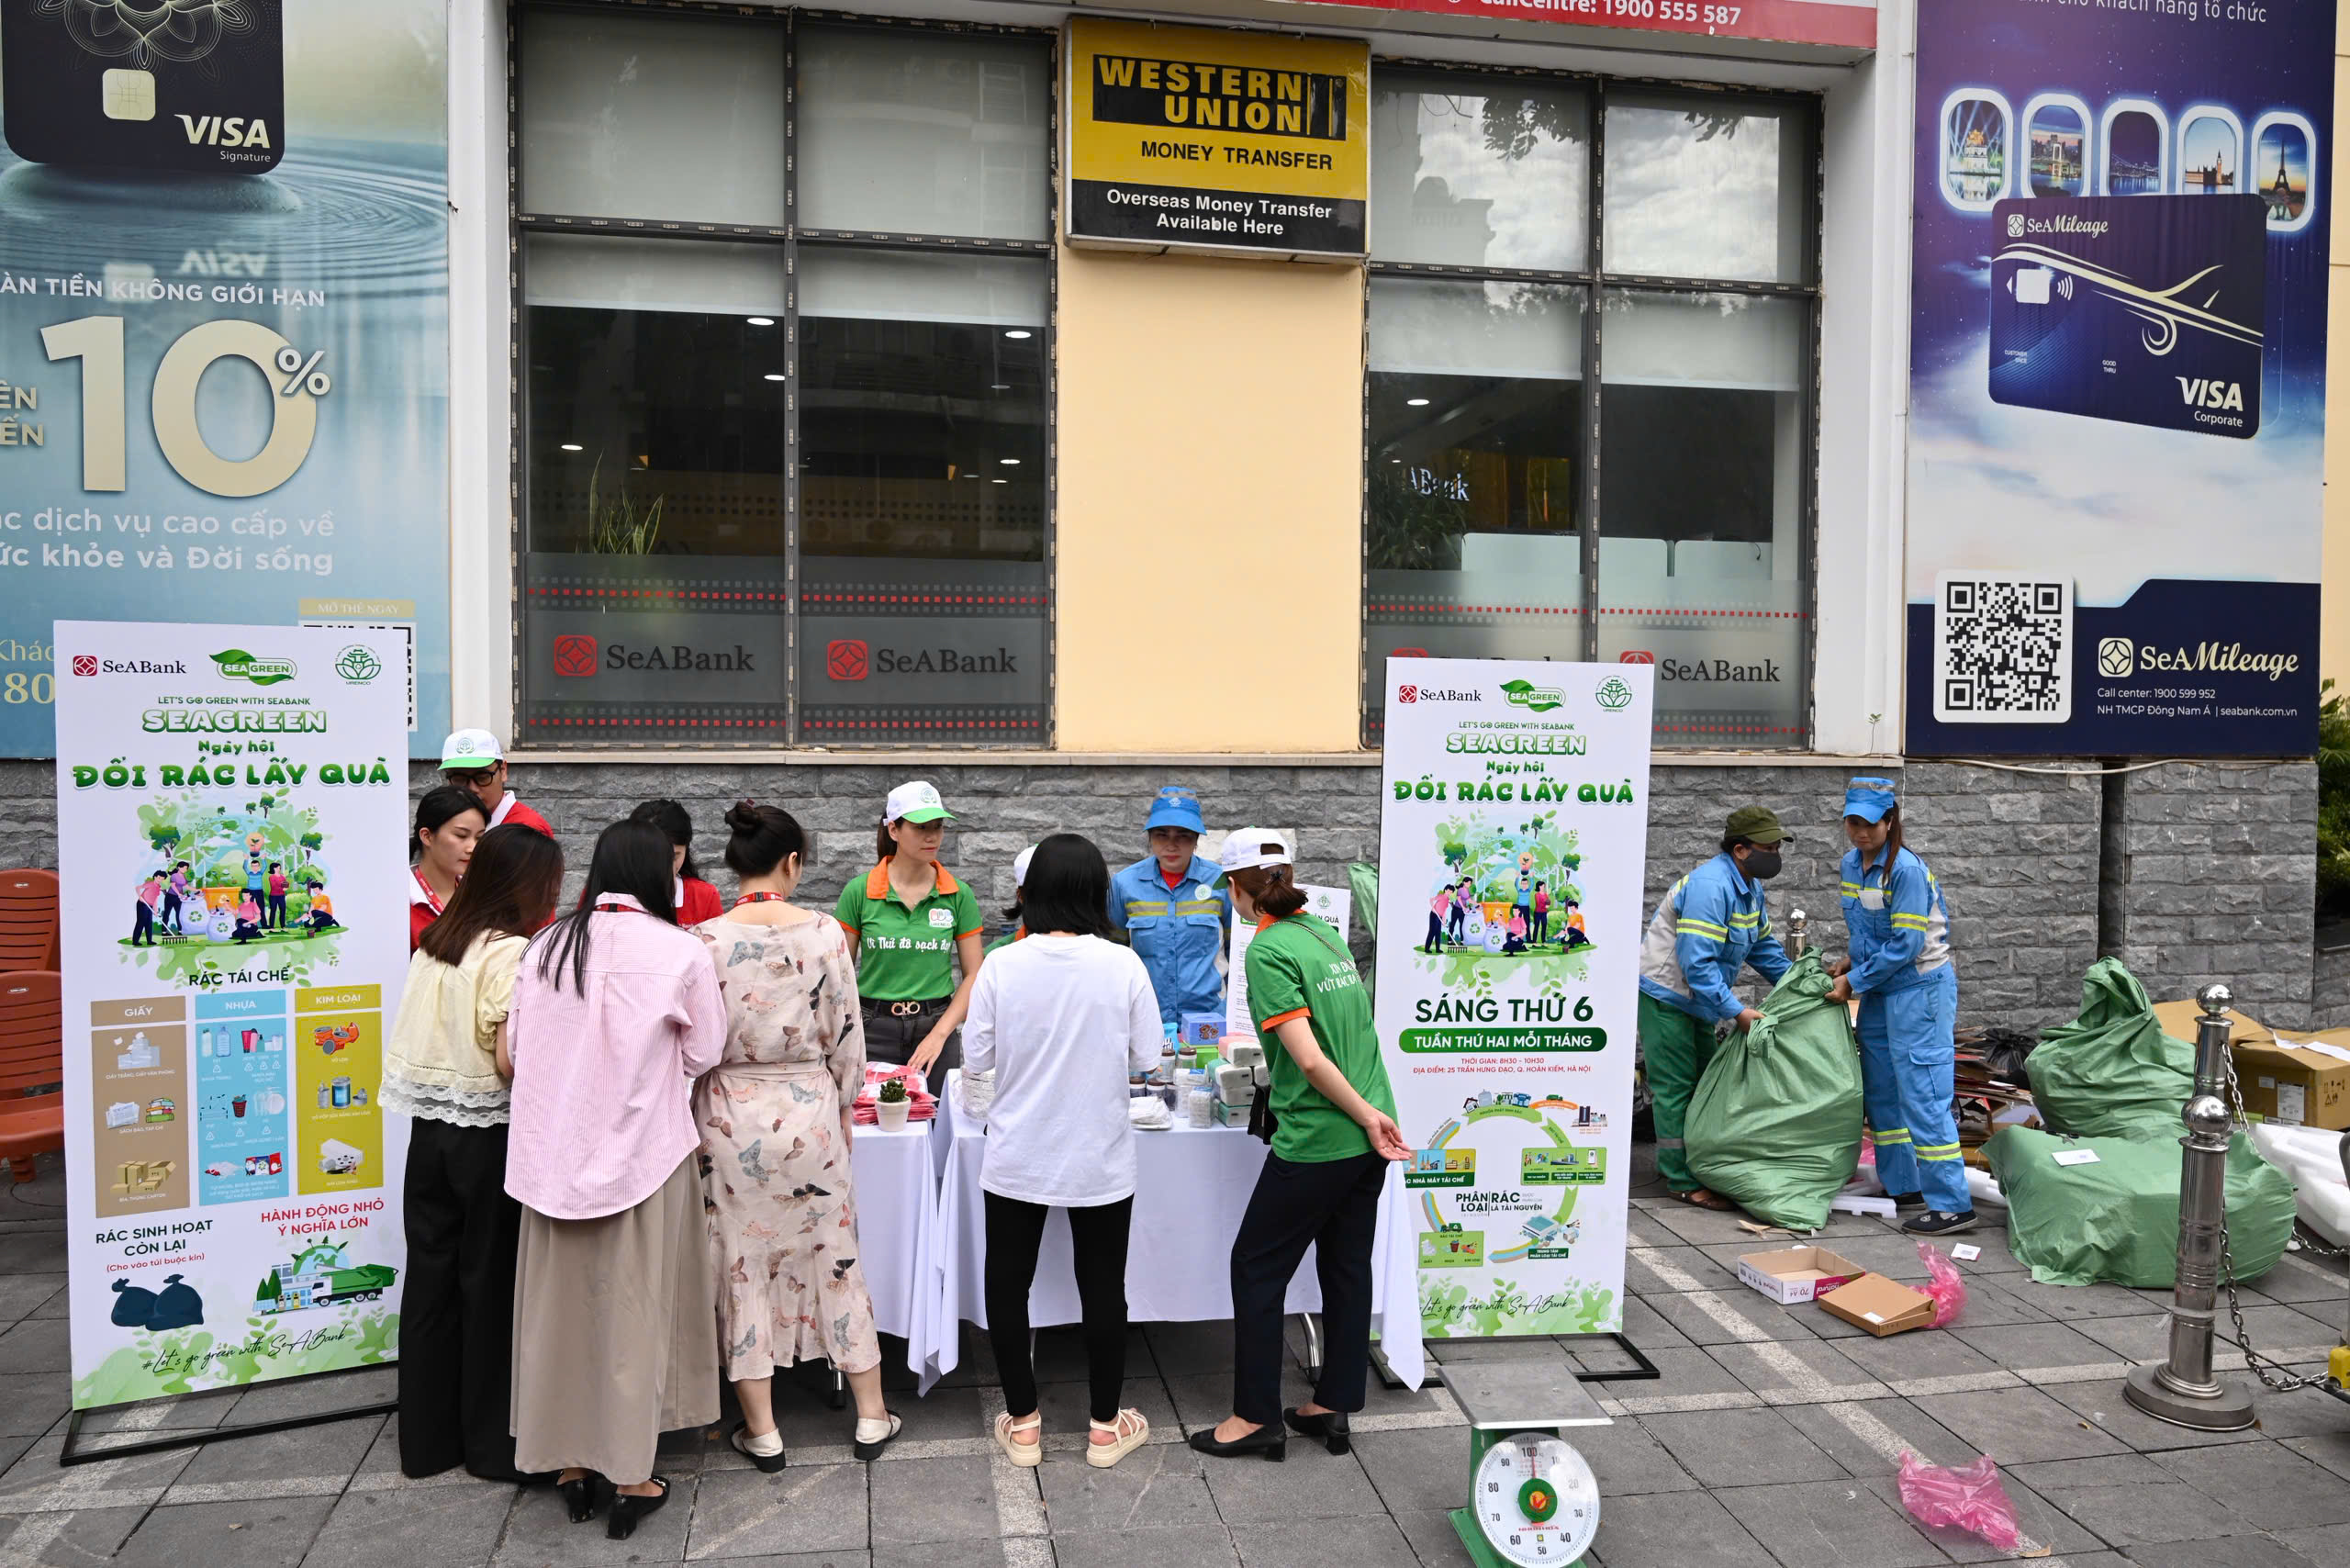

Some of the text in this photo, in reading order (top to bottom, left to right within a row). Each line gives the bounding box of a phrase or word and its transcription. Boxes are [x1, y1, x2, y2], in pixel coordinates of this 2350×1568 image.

[1604, 0, 1741, 26] 1900 555 587
[2227, 2, 2266, 23] chức
[1099, 57, 1302, 102] WESTERN
[1164, 95, 1302, 133] UNION
[173, 114, 271, 149] VISA
[220, 150, 271, 163] Signature
[1141, 140, 1333, 171] MONEY TRANSFER
[1106, 189, 1332, 218] Overseas Money Transfer
[1157, 213, 1284, 236] Available Here
[45, 273, 325, 312] TIỀN KHÔNG GIỚI HẠN
[2176, 375, 2244, 412] VISA
[2194, 410, 2244, 428] Corporate
[33, 507, 336, 542] dịch vụ cao cấp về
[42, 542, 334, 577] khỏe và Đời sống
[103, 660, 186, 675] SeABank
[606, 644, 755, 672] SeABank
[876, 647, 1018, 675] SeABank
[2140, 641, 2300, 682] SeAMileage
[1661, 659, 1781, 684] SeABank
[158, 696, 311, 706] LET'S GO GREEN WITH SEABANK
[1420, 689, 1482, 701] SeABank
[2097, 688, 2216, 700] Call center: 1900 599 952
[141, 709, 327, 734] SEAGREEN
[2097, 705, 2113, 715] NH
[2115, 705, 2145, 716] TMCP
[2147, 704, 2176, 719] Đông
[2177, 705, 2201, 716] Nam
[2220, 705, 2298, 718] seabank.com.vn
[1494, 722, 1519, 730] GREEN
[1521, 722, 1539, 730] WITH
[1540, 722, 1575, 731] SEABANK
[197, 739, 243, 756] Ngày
[1446, 733, 1587, 756] SEAGREEN
[73, 756, 391, 788] ĐỔI RÁC LẤY QUÀ
[1486, 760, 1520, 775] Ngày
[1393, 774, 1634, 803] ĐỔI RÁC LẤY QUÀ
[188, 965, 289, 987] RÁC TÁI CHẾ
[225, 999, 257, 1012] NHỰA
[315, 992, 361, 1005] KIM LOẠI
[1415, 992, 1499, 1023] SÁNG
[1572, 996, 1594, 1022] 6
[124, 1003, 153, 1017] GIẤY
[1414, 1030, 1593, 1048] TUẦN THỨ HAI MỖI THÁNG
[1456, 1191, 1488, 1203] PHÂN
[1491, 1190, 1521, 1203] RÁC
[261, 1195, 385, 1225] HÀNH ĐỘNG NHỎ
[1460, 1203, 1488, 1215] LOẠI
[95, 1220, 214, 1244] RÁC SINH HOẠT
[277, 1215, 369, 1237] Ý NGHĨA LỚN
[124, 1238, 187, 1257] CÒN LẠI
[106, 1262, 129, 1272] (Cho
[130, 1260, 149, 1269] vào
[203, 1350, 236, 1369] green
[238, 1337, 264, 1355] with
[1501, 1458, 1510, 1467] 90
[1521, 1447, 1538, 1458] 100
[1488, 1478, 1579, 1493] 80 20
[1492, 1509, 1583, 1522] 70 30
[1510, 1532, 1571, 1545] 60 40
[1538, 1546, 1547, 1555] 50
